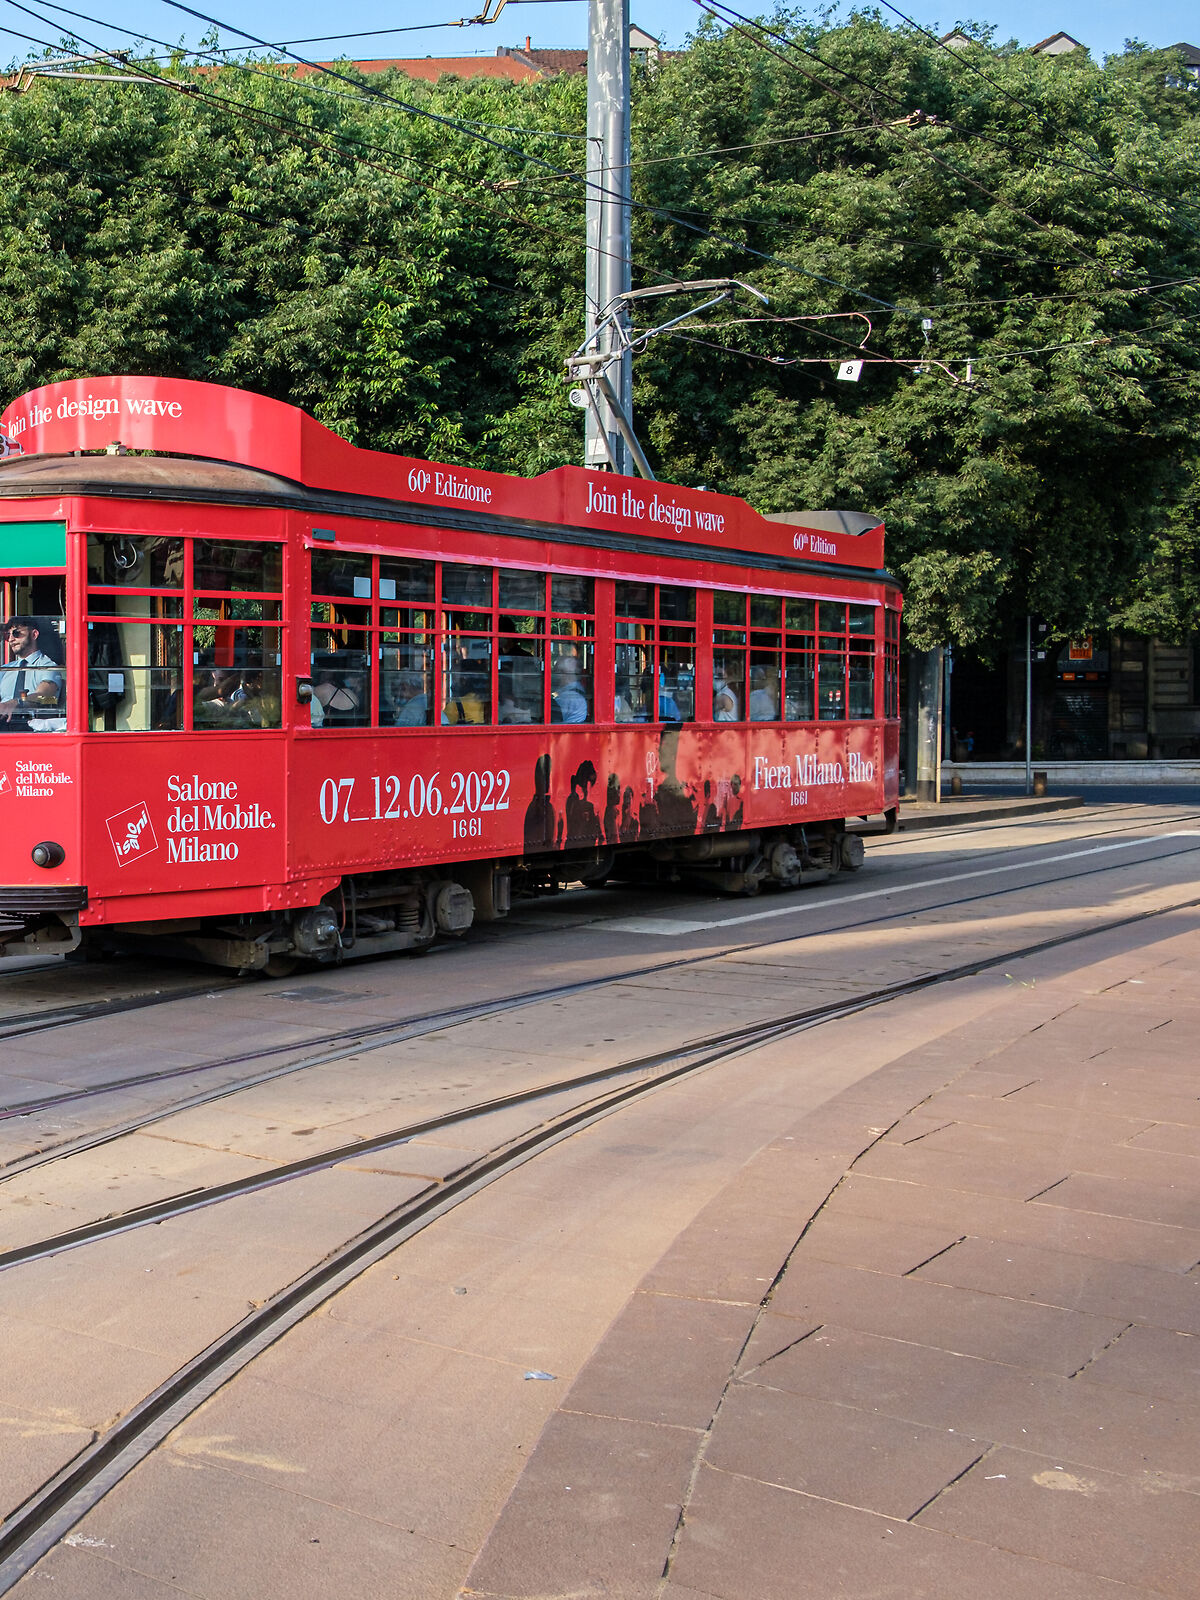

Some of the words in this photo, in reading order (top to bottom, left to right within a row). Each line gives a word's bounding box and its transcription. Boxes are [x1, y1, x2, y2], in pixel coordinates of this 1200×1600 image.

[846, 365, 854, 375] 8
[8, 416, 26, 439] Join
[29, 404, 52, 427] the
[56, 394, 120, 421] design
[125, 398, 183, 418] wave
[434, 472, 492, 503] Edizione
[585, 481, 617, 515] Join
[622, 489, 645, 520] the
[649, 494, 692, 534] design
[694, 510, 725, 533] wave
[810, 535, 836, 555] Edition
[16, 761, 52, 772] Salone
[16, 773, 33, 784] del
[34, 773, 73, 784] Mobile.
[754, 757, 791, 790] Fiera
[795, 754, 845, 788] Milano,
[848, 752, 874, 783] Rho
[16, 786, 53, 796] Milano
[167, 775, 238, 802] Salone
[319, 769, 510, 824] 07_12.06.2022
[790, 791, 808, 806] 1661
[167, 806, 200, 833] del
[202, 803, 276, 831] Mobile.
[452, 818, 482, 838] 1661
[166, 837, 239, 864] Milano
